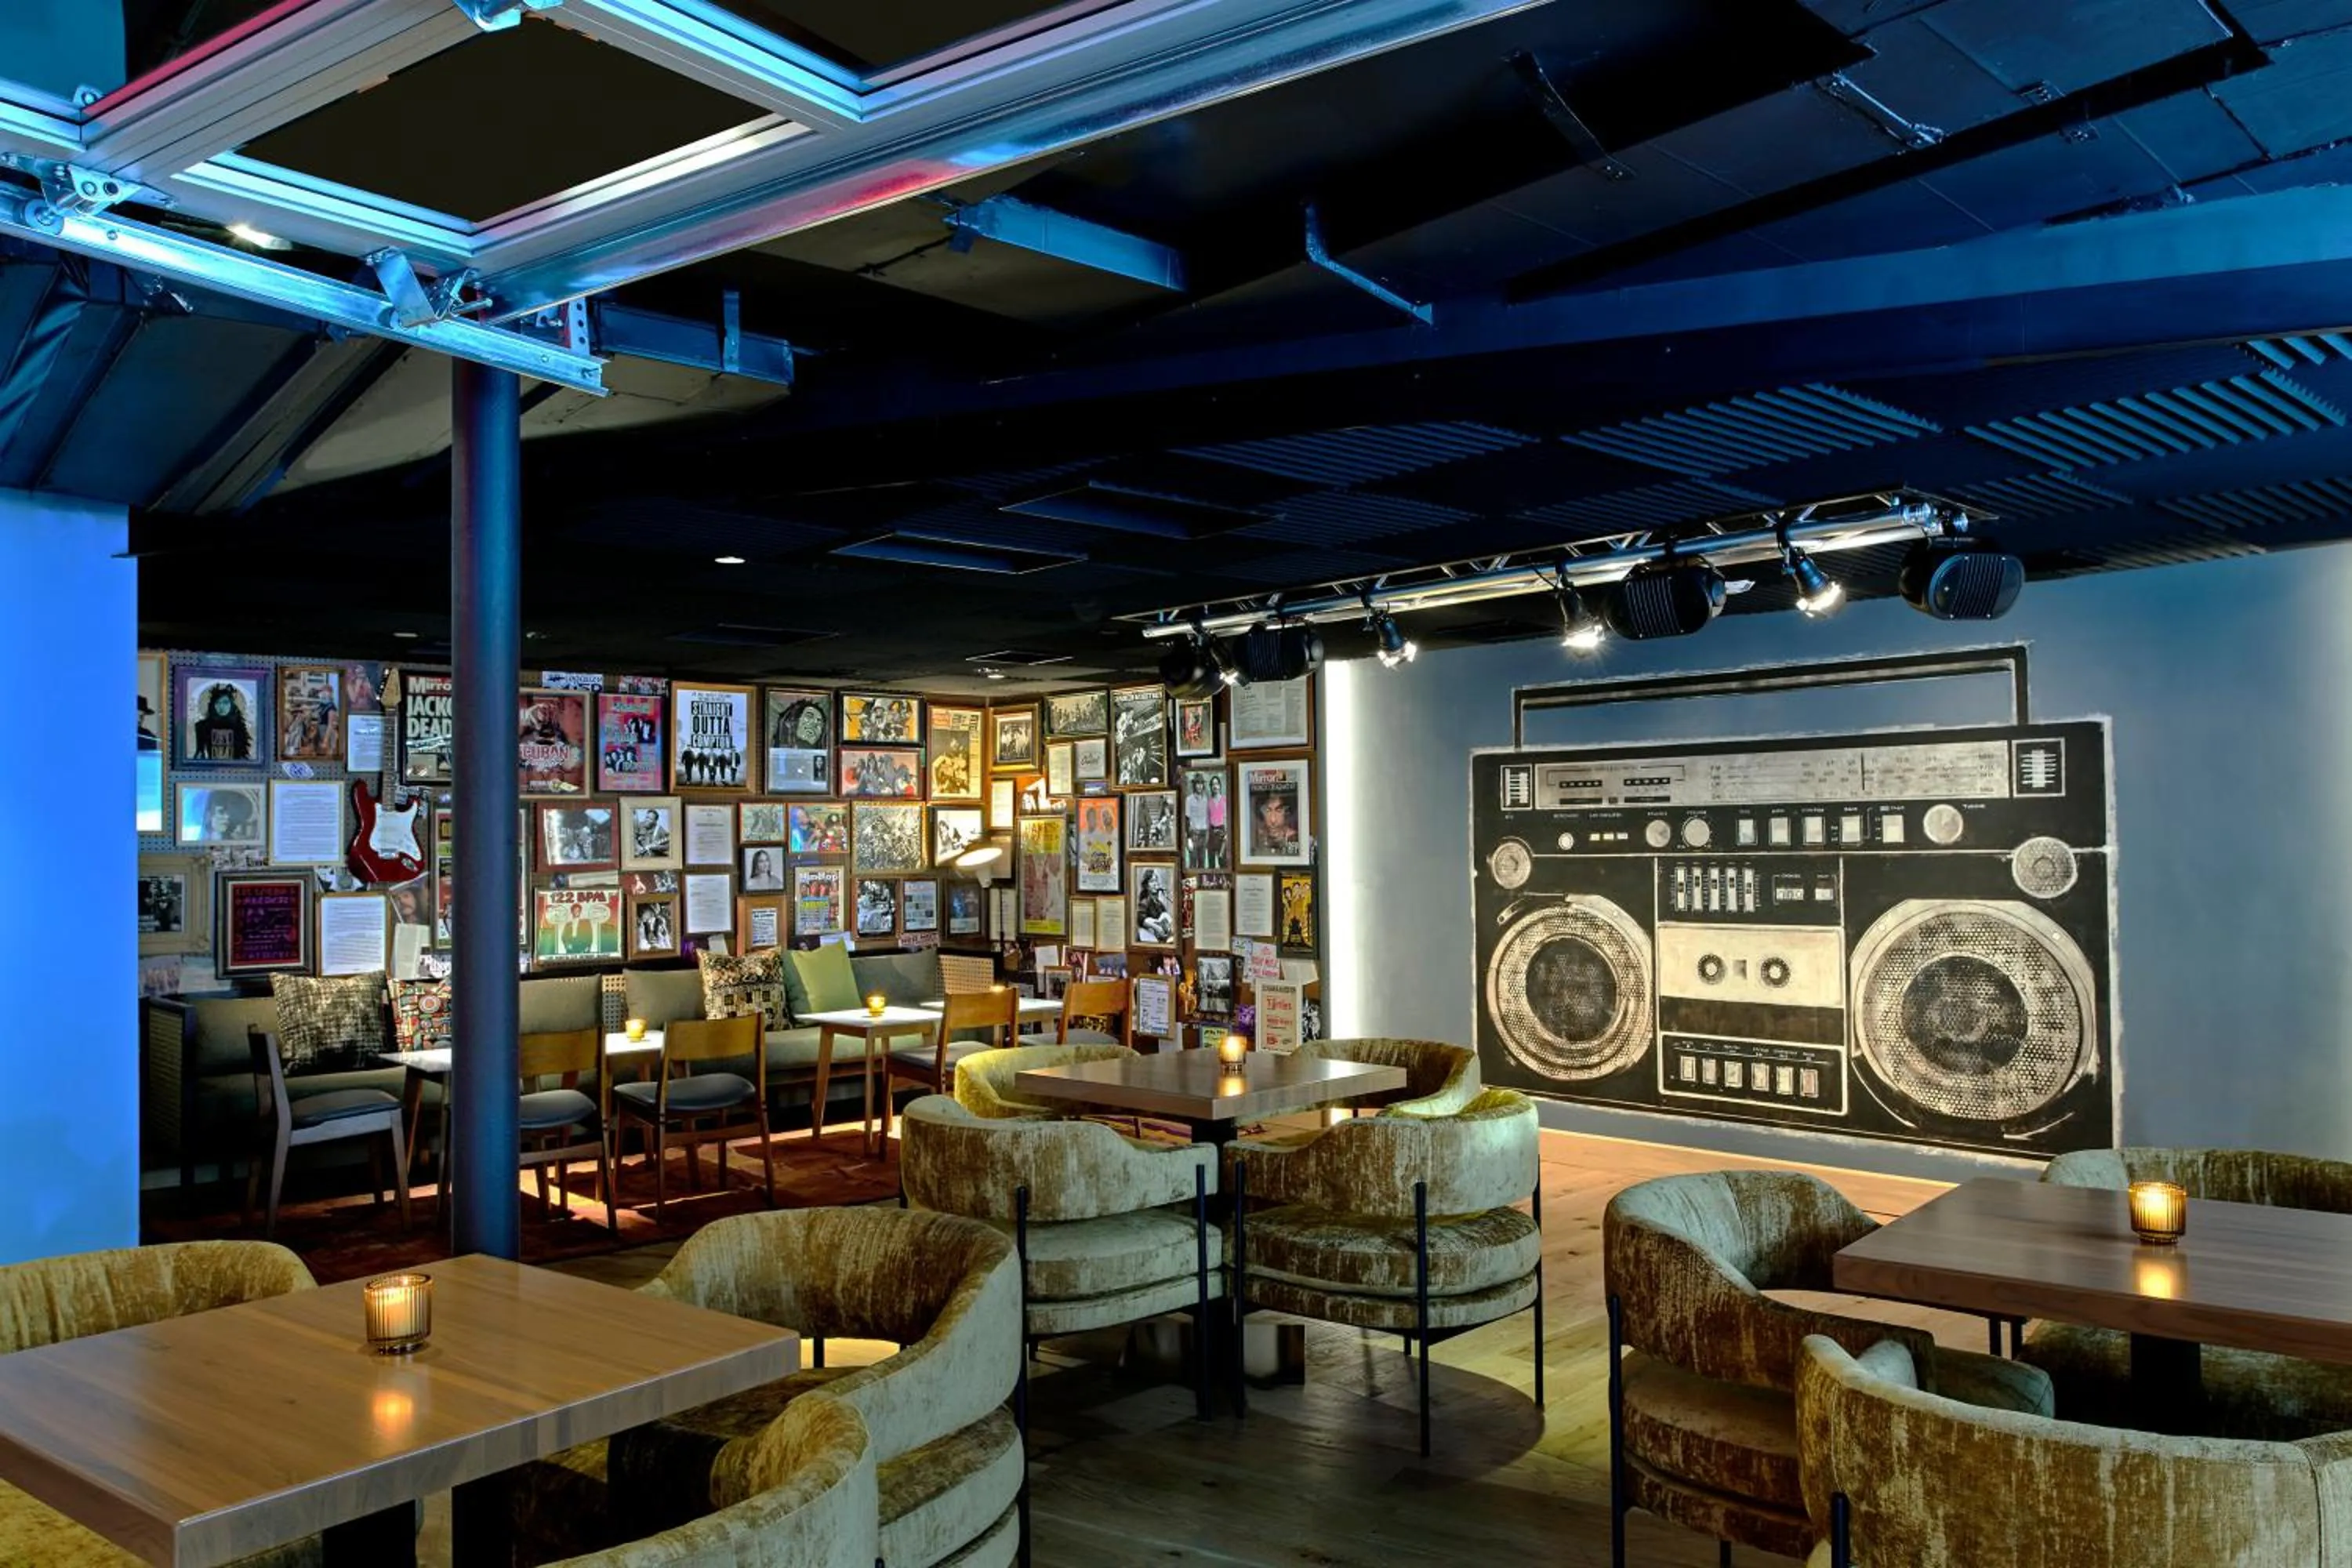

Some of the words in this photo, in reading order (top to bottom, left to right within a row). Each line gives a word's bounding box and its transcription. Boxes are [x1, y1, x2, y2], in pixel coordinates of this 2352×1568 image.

[408, 677, 452, 694] Mirro
[407, 717, 452, 738] DEAD
[692, 716, 730, 734] OUTTA
[551, 892, 575, 903] 122
[577, 891, 607, 902] BPM
